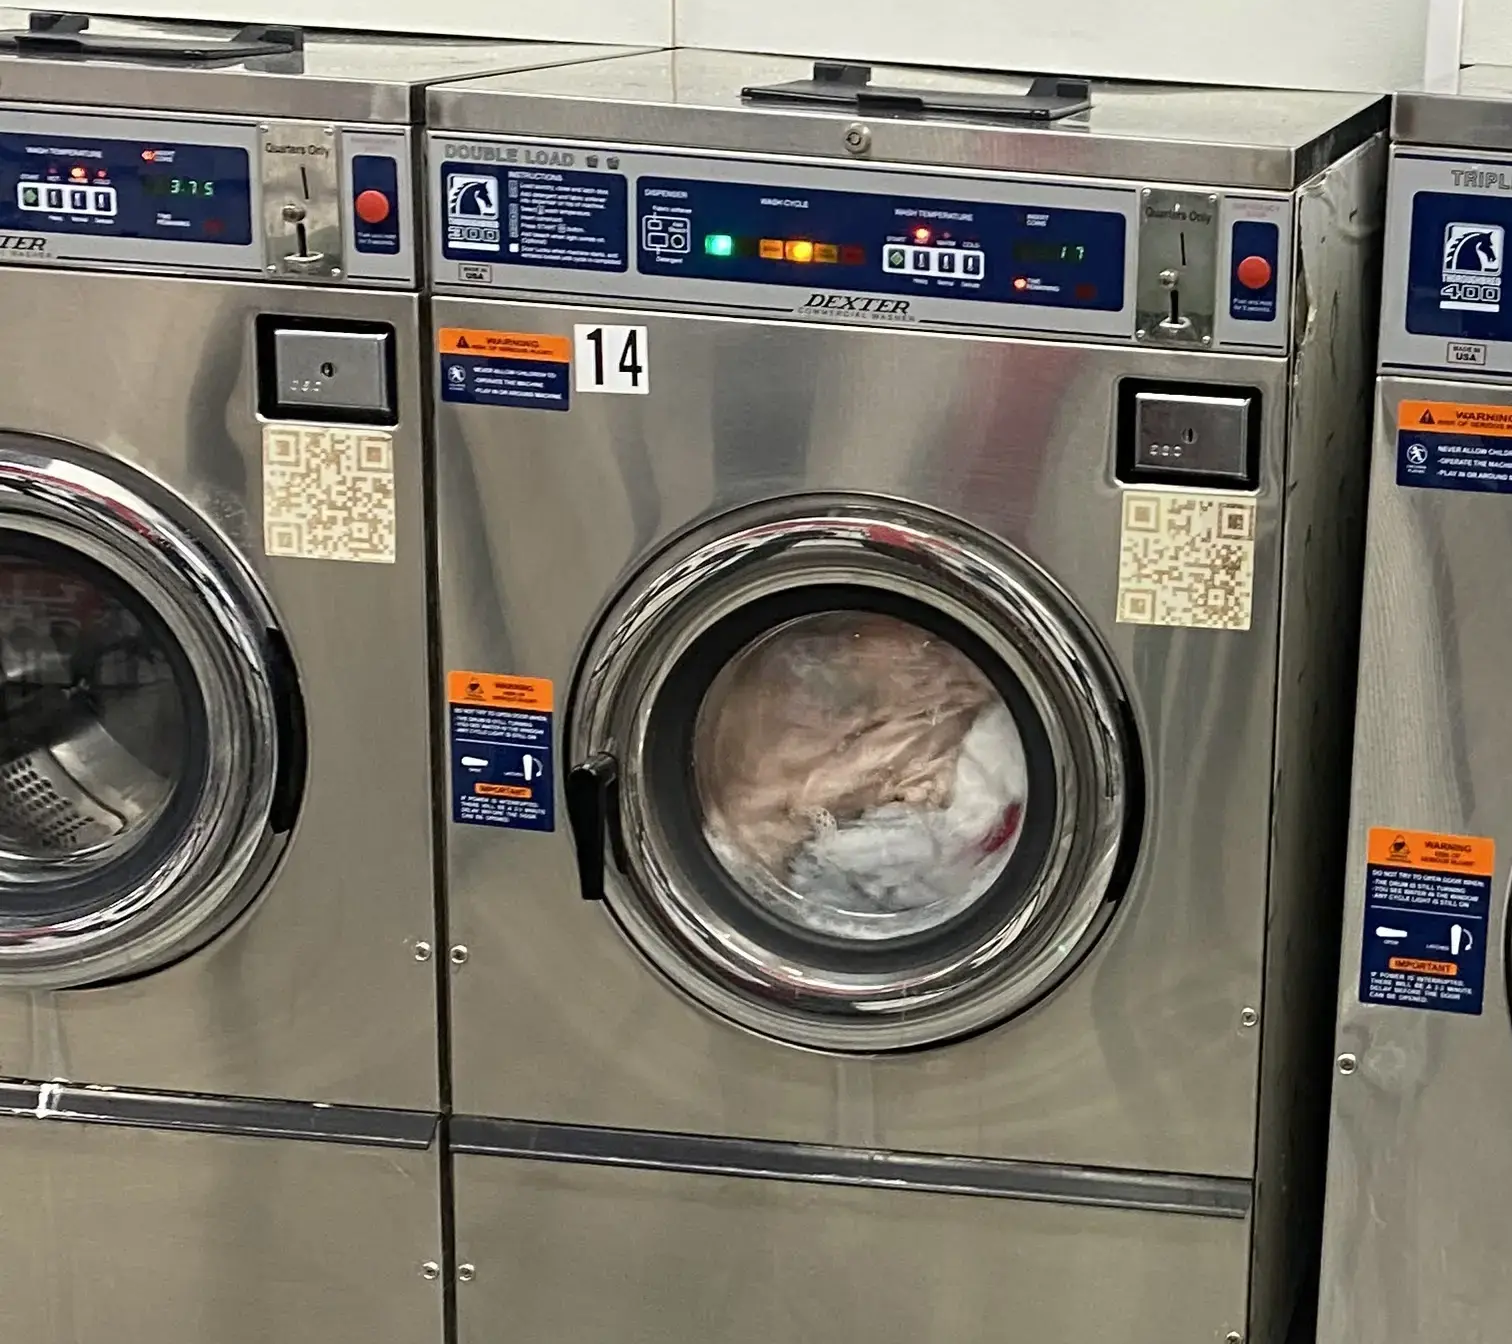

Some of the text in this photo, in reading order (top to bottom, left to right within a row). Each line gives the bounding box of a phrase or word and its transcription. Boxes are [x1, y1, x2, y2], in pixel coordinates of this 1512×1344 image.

[444, 143, 575, 167] DOUBLE LOAD
[1440, 284, 1500, 302] 400
[802, 293, 911, 316] DEXTER
[586, 328, 643, 387] 14
[1455, 353, 1476, 362] USA
[1462, 447, 1487, 455] ALLOW
[1425, 841, 1472, 852] WARNING
[1395, 960, 1450, 972] IMPORTANT
